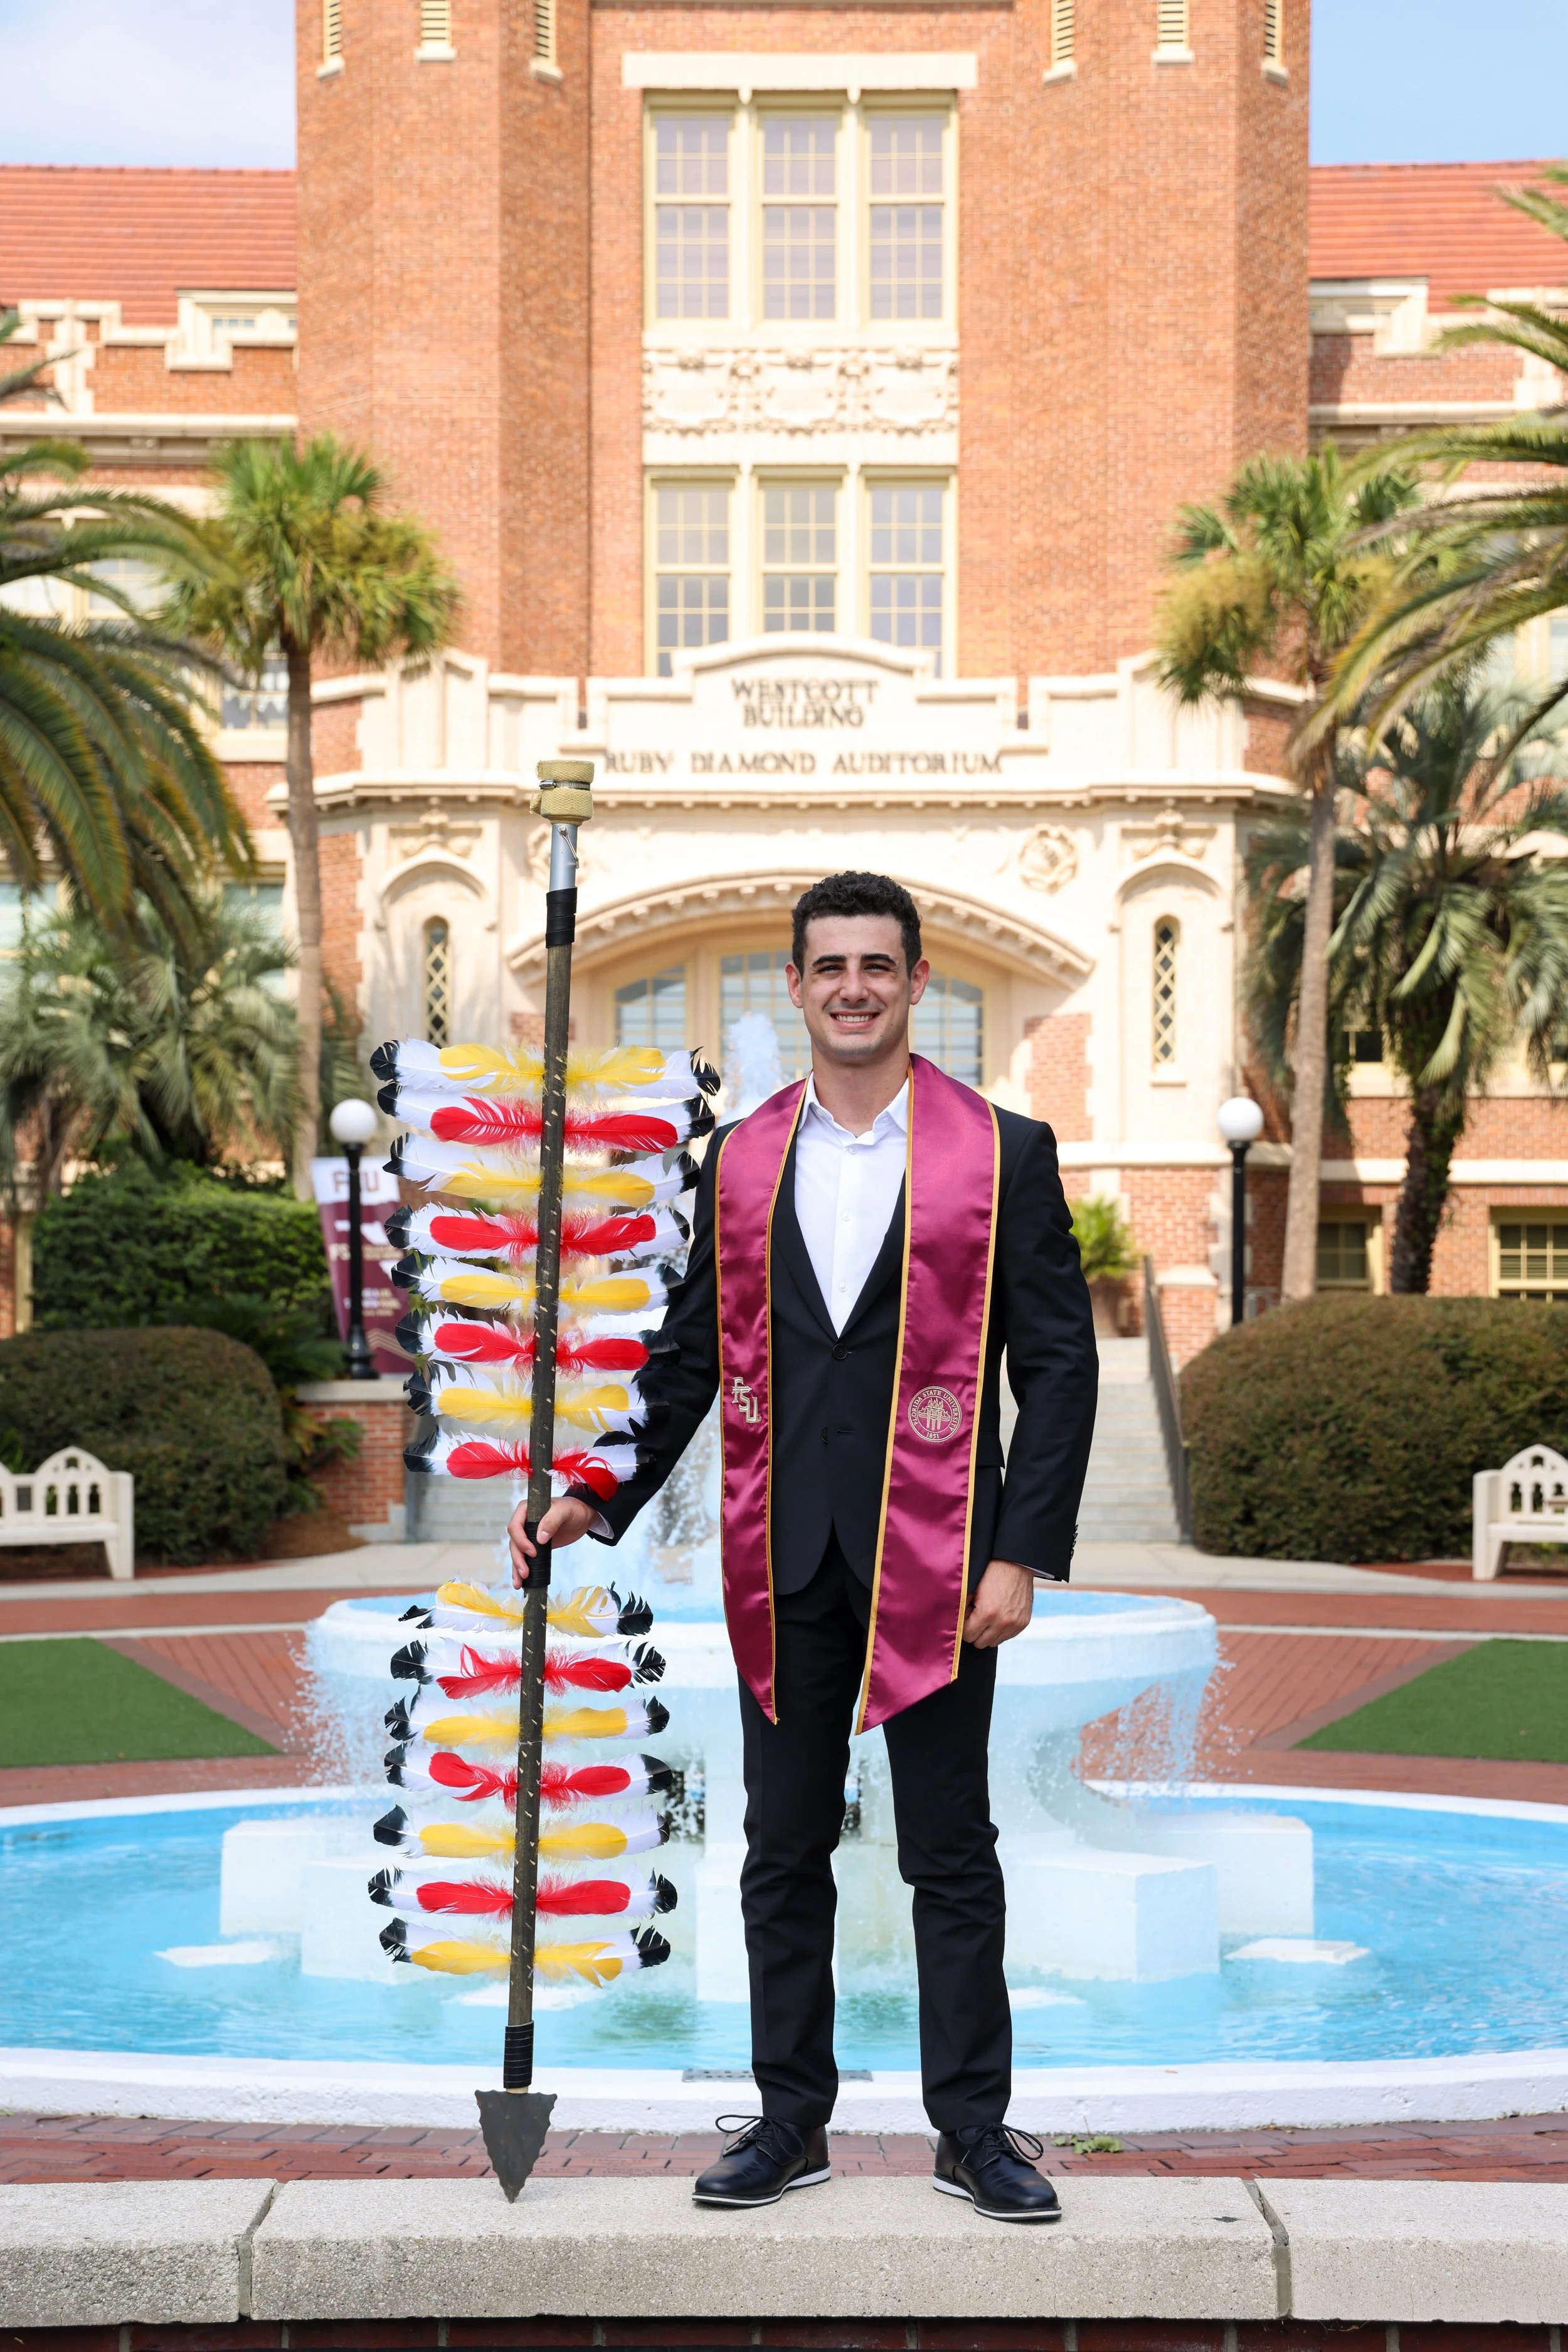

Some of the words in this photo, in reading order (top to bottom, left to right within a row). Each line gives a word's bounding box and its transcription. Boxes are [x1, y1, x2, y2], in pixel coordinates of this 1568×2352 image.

[731, 679, 879, 703] WESTCOTT
[743, 703, 865, 728] BUILDING
[604, 751, 674, 774] RUBY
[691, 751, 817, 774] DIAMOND
[832, 751, 1004, 774] AUDITORIUM
[332, 1169, 380, 1193] FU
[731, 1376, 758, 1423] FSU
[911, 1397, 923, 1425] FLORIDA
[943, 1393, 958, 1432] UNIVERSITY
